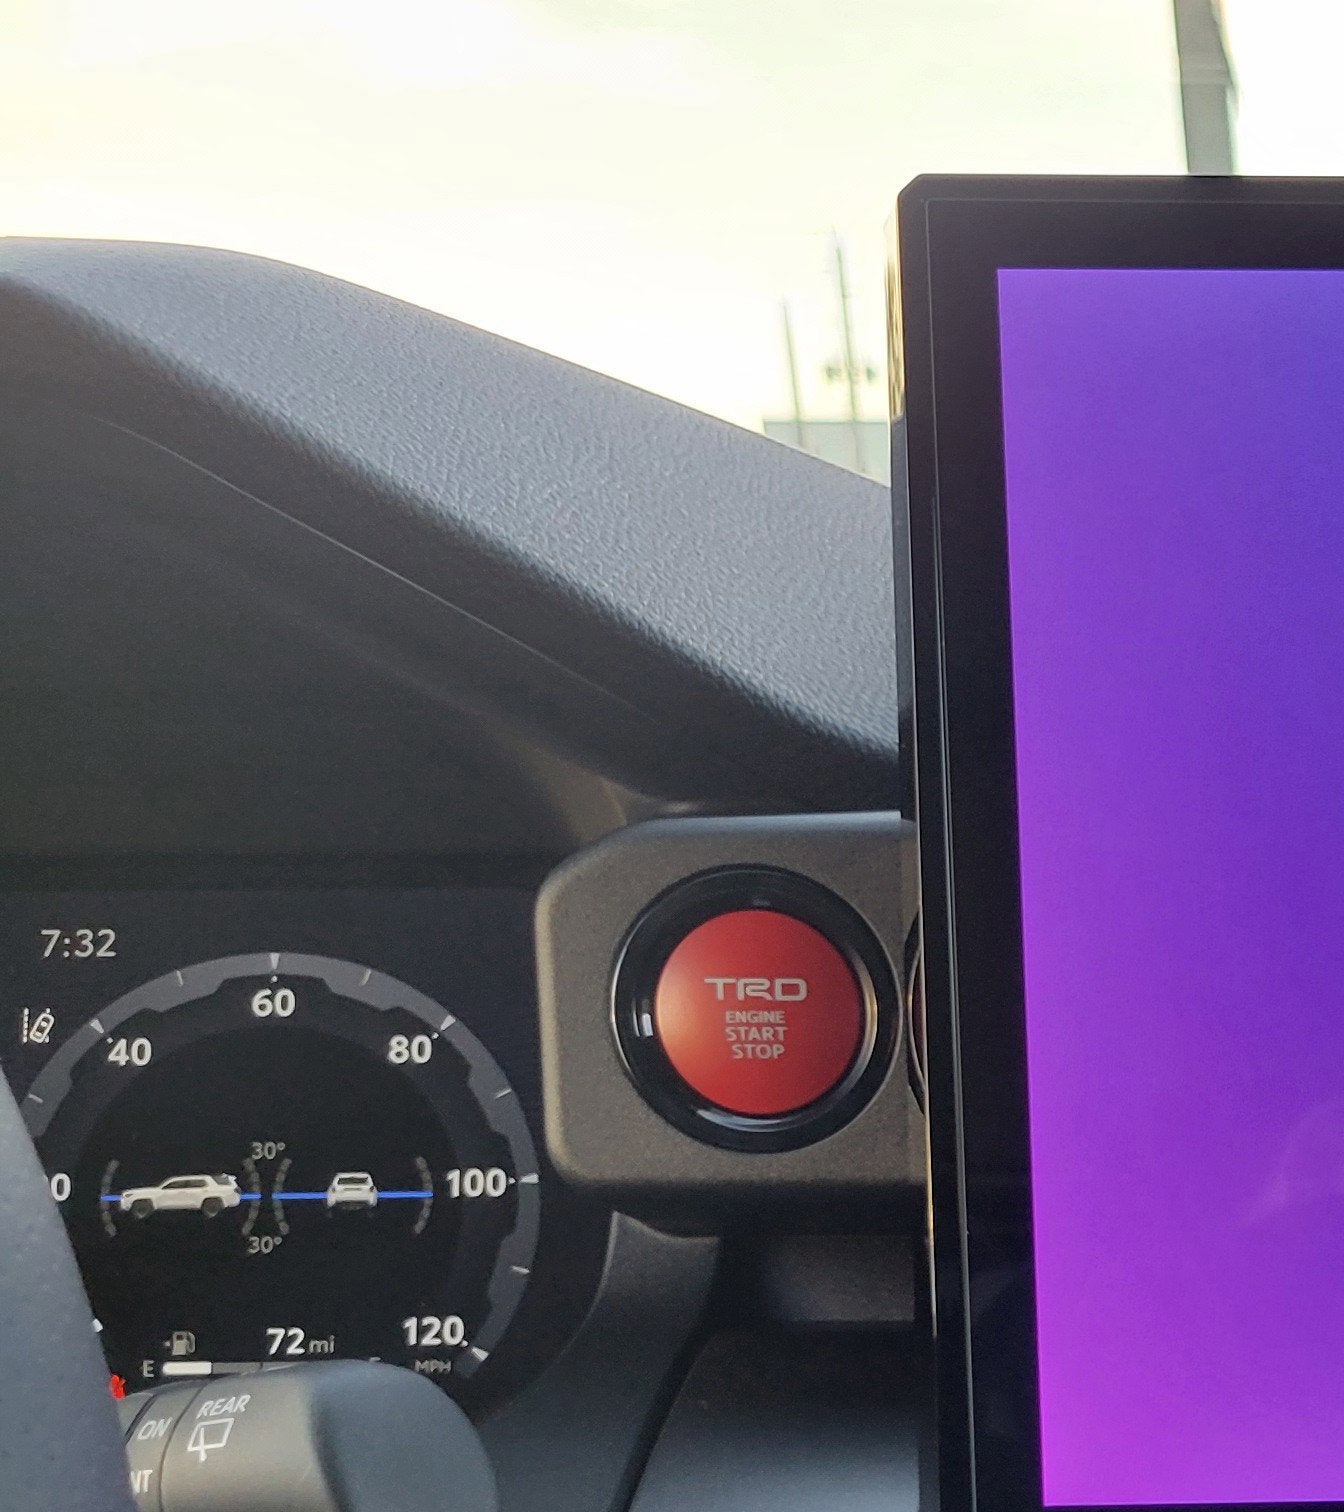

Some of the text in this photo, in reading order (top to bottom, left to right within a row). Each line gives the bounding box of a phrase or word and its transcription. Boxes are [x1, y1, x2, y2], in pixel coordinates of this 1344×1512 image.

[40, 928, 117, 958] 7:32
[704, 978, 807, 1001] TRD
[251, 988, 296, 1018] 60
[725, 1010, 786, 1024] ENGINE
[725, 1026, 789, 1041] START
[108, 1037, 152, 1066] 40
[388, 1037, 432, 1065] 80
[732, 1044, 785, 1059] STOP
[250, 1141, 286, 1160] 30°
[50, 1173, 72, 1202] 0
[446, 1169, 508, 1198] 100
[248, 1234, 284, 1255] 30°
[266, 1327, 335, 1356] 72 mi
[402, 1315, 465, 1346] 120
[143, 1360, 154, 1377] E
[414, 1360, 452, 1374] MPH
[196, 1394, 251, 1419] REAR
[137, 1417, 172, 1440] ON
[130, 1469, 153, 1494] NT
